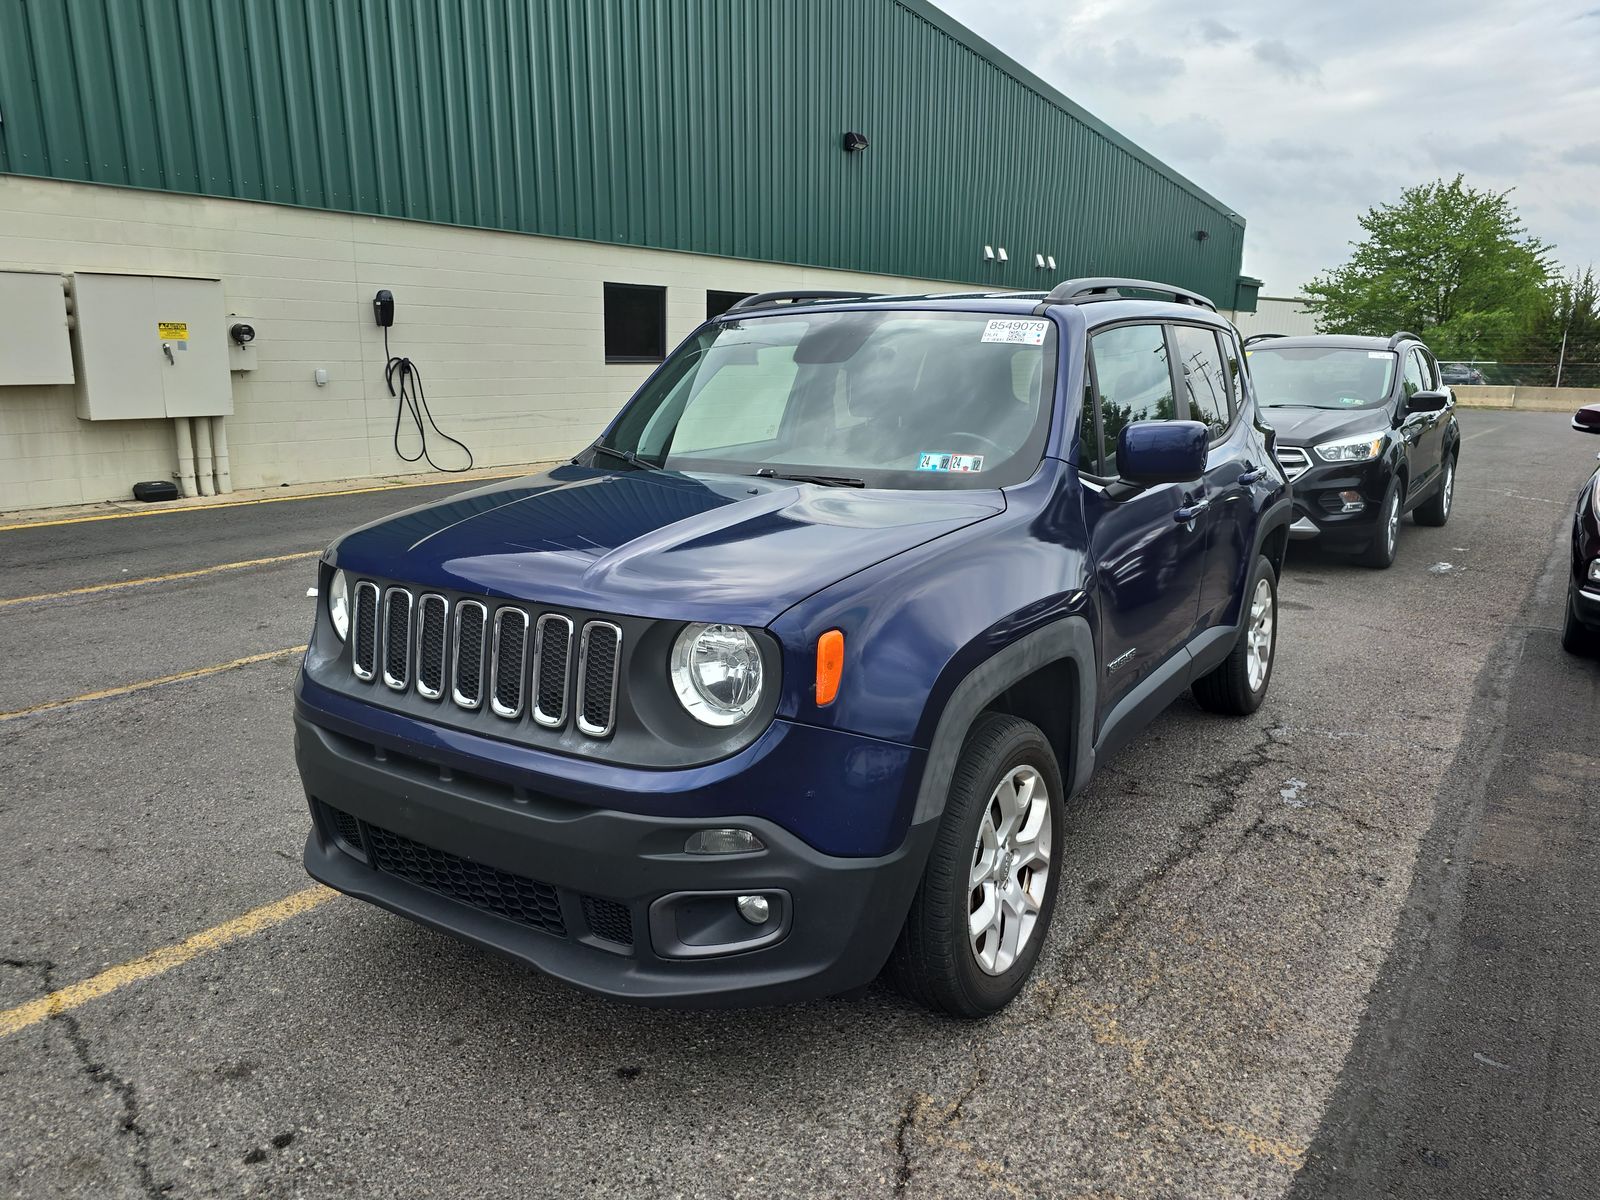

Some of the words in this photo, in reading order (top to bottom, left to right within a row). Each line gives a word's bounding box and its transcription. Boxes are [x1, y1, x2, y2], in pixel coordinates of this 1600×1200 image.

[989, 321, 1045, 332] 8549079
[921, 455, 931, 468] 24
[952, 456, 962, 469] 24
[972, 459, 981, 471] 12
